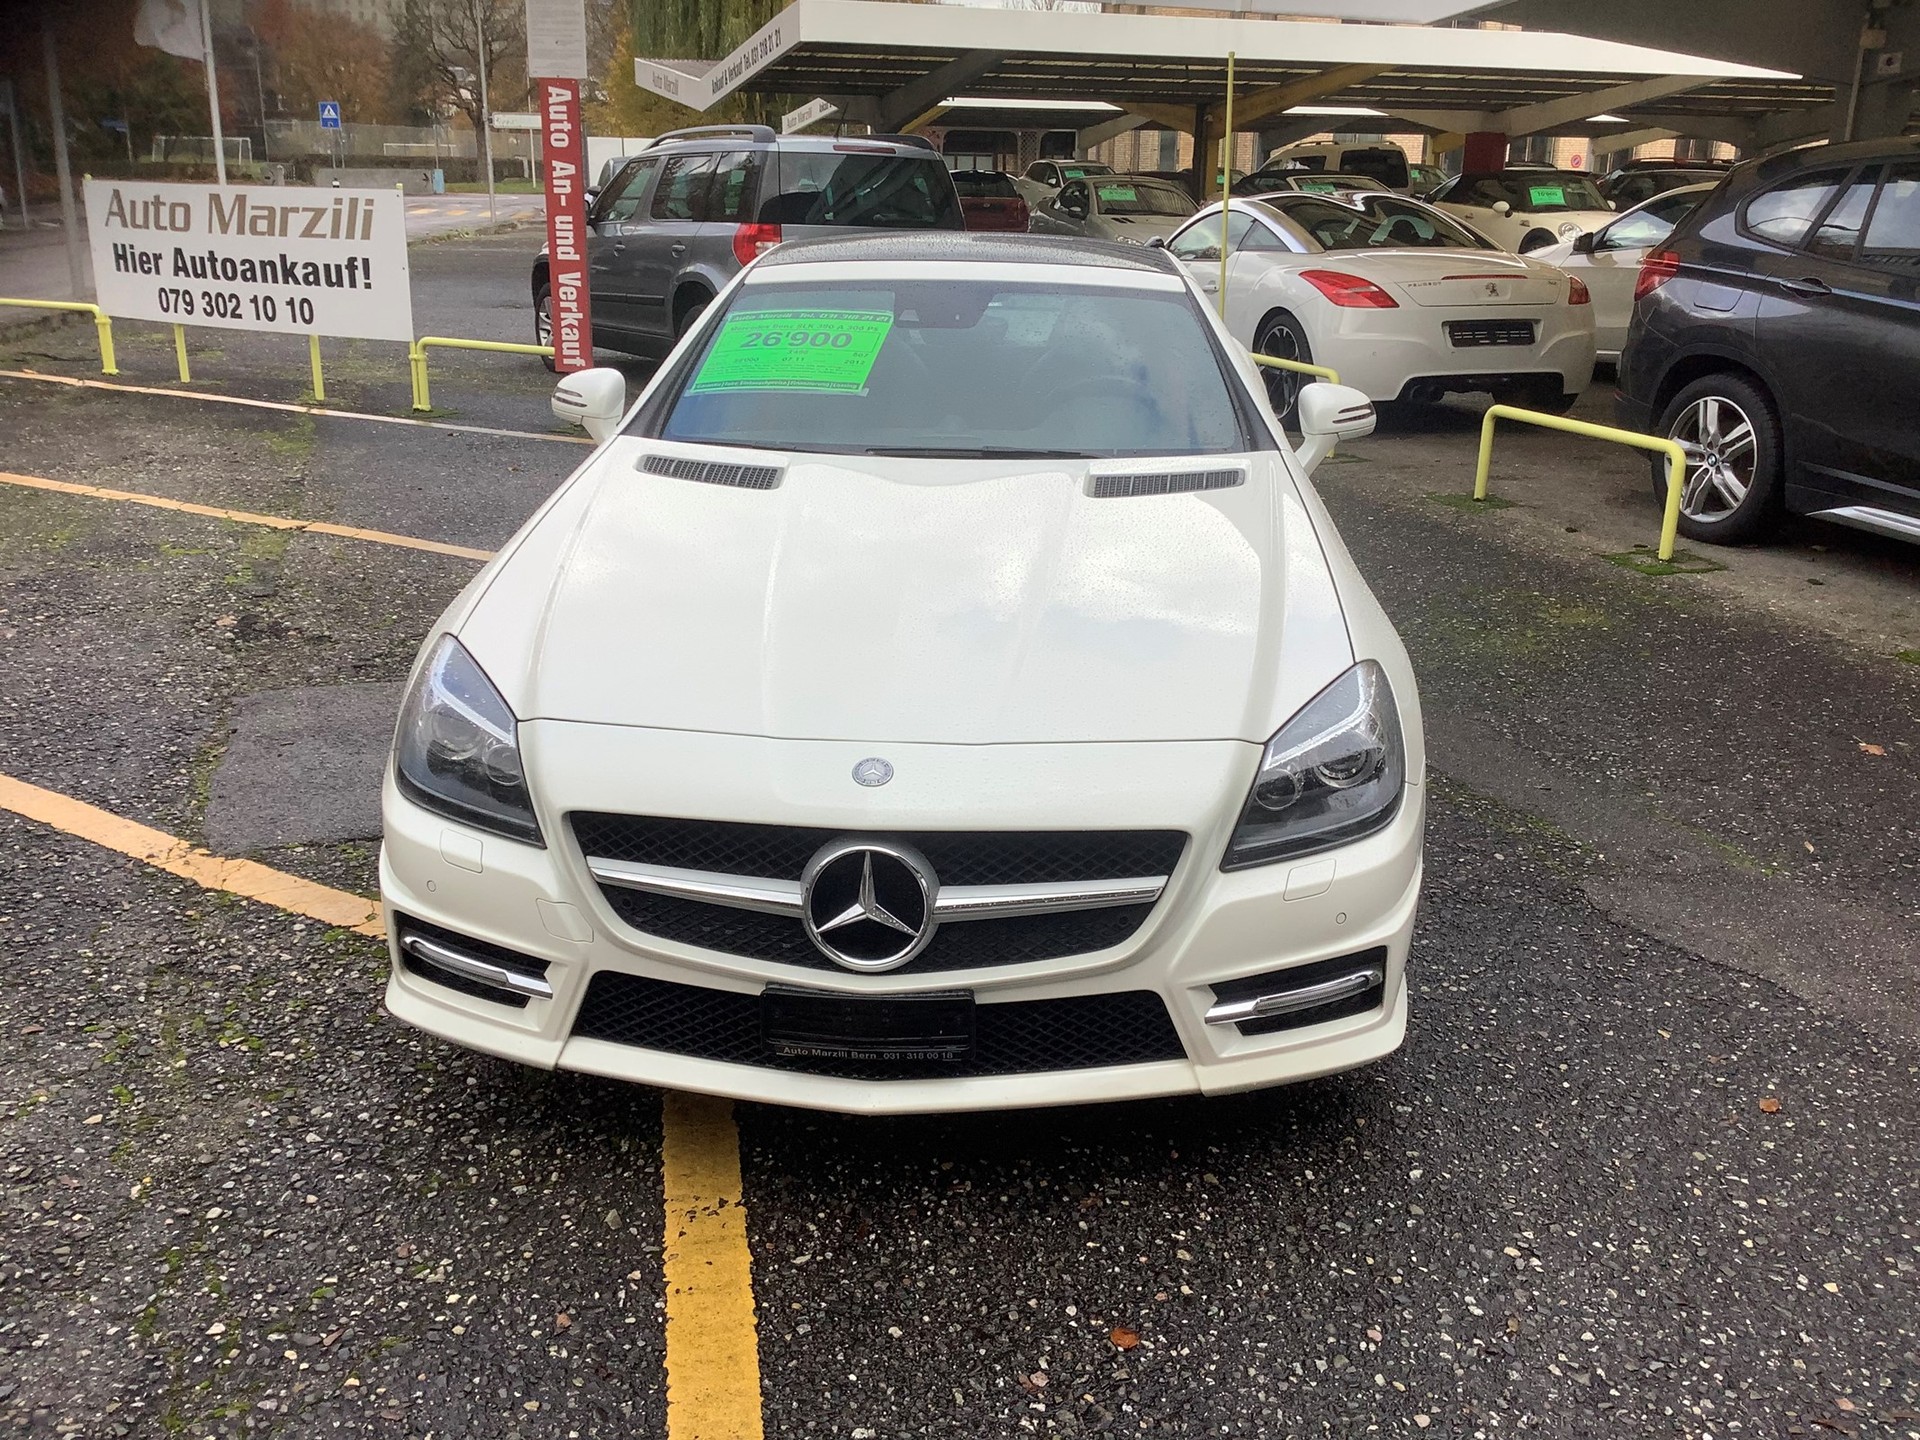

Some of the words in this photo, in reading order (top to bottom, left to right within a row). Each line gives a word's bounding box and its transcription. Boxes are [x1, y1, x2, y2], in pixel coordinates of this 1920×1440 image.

[728, 56, 744, 83] Verkauf
[751, 44, 760, 66] 031
[759, 38, 769, 60] 318
[767, 32, 775, 53] 21
[775, 26, 782, 48] 21
[546, 86, 571, 149] Auto
[550, 160, 574, 208] An-
[104, 188, 192, 232] Auto
[207, 193, 375, 241] Marzili
[554, 215, 577, 262] und
[113, 242, 164, 276] Hier
[172, 248, 373, 289] Autoankauf!
[157, 287, 195, 316] 079
[201, 291, 243, 320] 302
[249, 295, 277, 323] 10
[285, 297, 315, 326] 10
[556, 271, 585, 368] Verkauf
[740, 331, 853, 349] 26'900
[783, 1047, 808, 1056] Auto
[812, 1049, 848, 1058] Marzili
[851, 1052, 877, 1060] Bern
[883, 1052, 900, 1060] 031
[906, 1052, 924, 1060] 318
[926, 1052, 939, 1060] 00
[942, 1051, 953, 1059] 18
